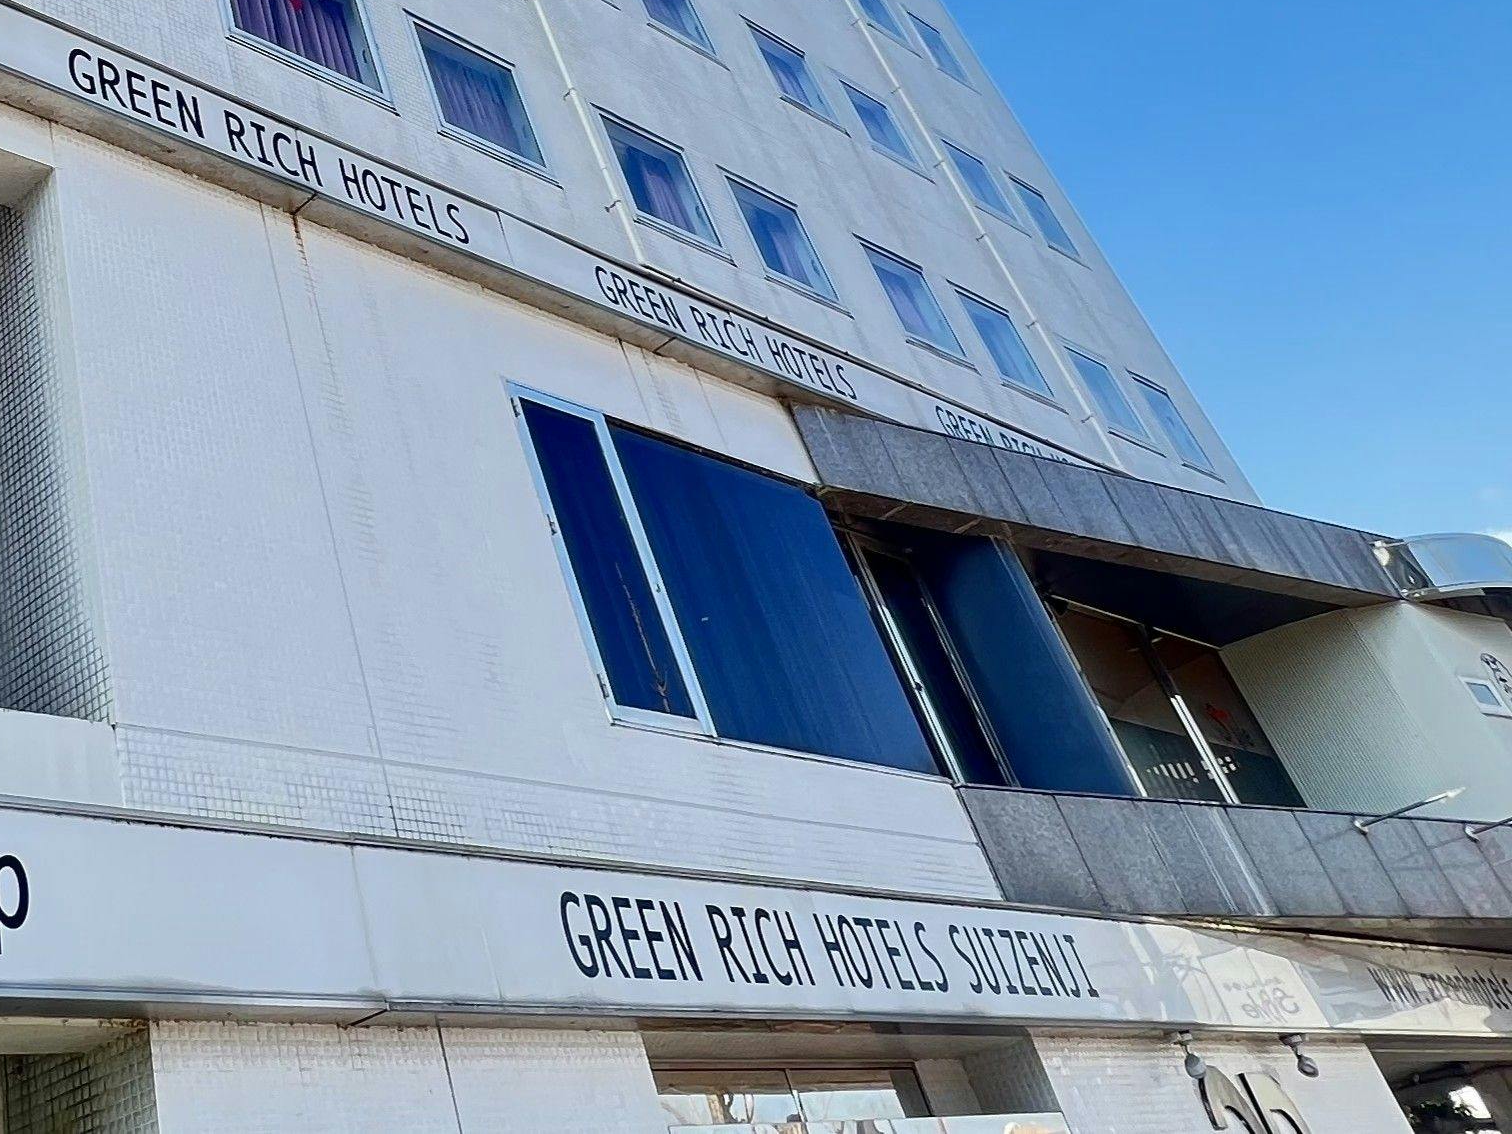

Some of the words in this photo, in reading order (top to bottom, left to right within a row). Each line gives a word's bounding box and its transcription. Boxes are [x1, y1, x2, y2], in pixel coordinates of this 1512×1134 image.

[68, 49, 205, 139] GREEN
[223, 109, 323, 187] RICH
[339, 158, 470, 244] HOTELS
[594, 265, 686, 334] GREEN
[690, 305, 762, 362] RICH
[765, 335, 858, 401] HOTELS
[935, 405, 996, 446] GREEN
[560, 891, 701, 982] GREEN
[705, 904, 817, 987] RICH
[817, 912, 950, 994] HOTELS
[948, 922, 1100, 999] SUIZENJI
